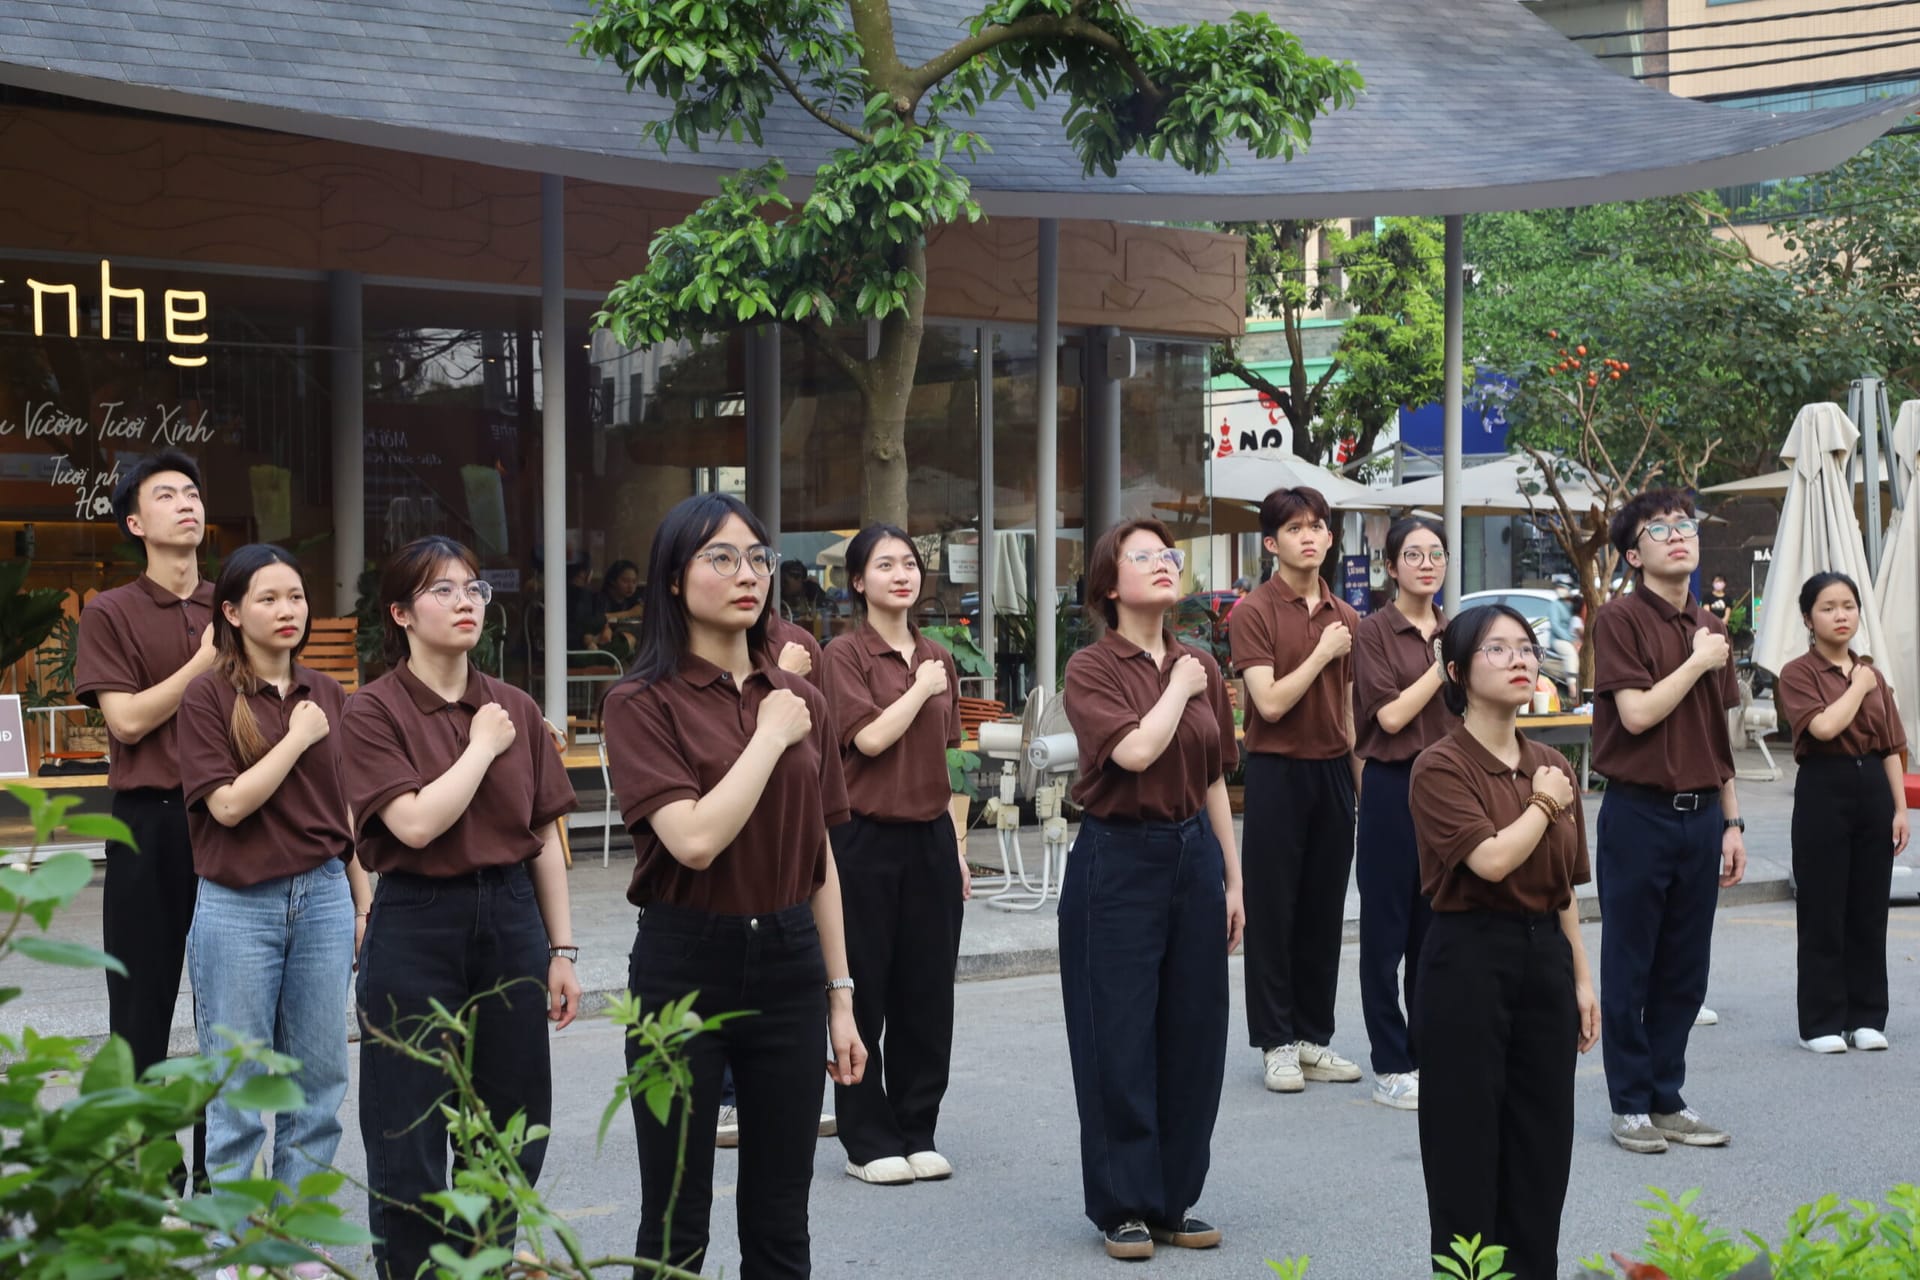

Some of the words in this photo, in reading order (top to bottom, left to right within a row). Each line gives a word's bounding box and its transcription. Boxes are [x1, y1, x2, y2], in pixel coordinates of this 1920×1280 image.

[25, 400, 88, 440] Vườn
[99, 401, 147, 441] Tươi
[152, 403, 214, 446] Xinh
[51, 454, 90, 487] Tươi
[95, 460, 126, 487] nh
